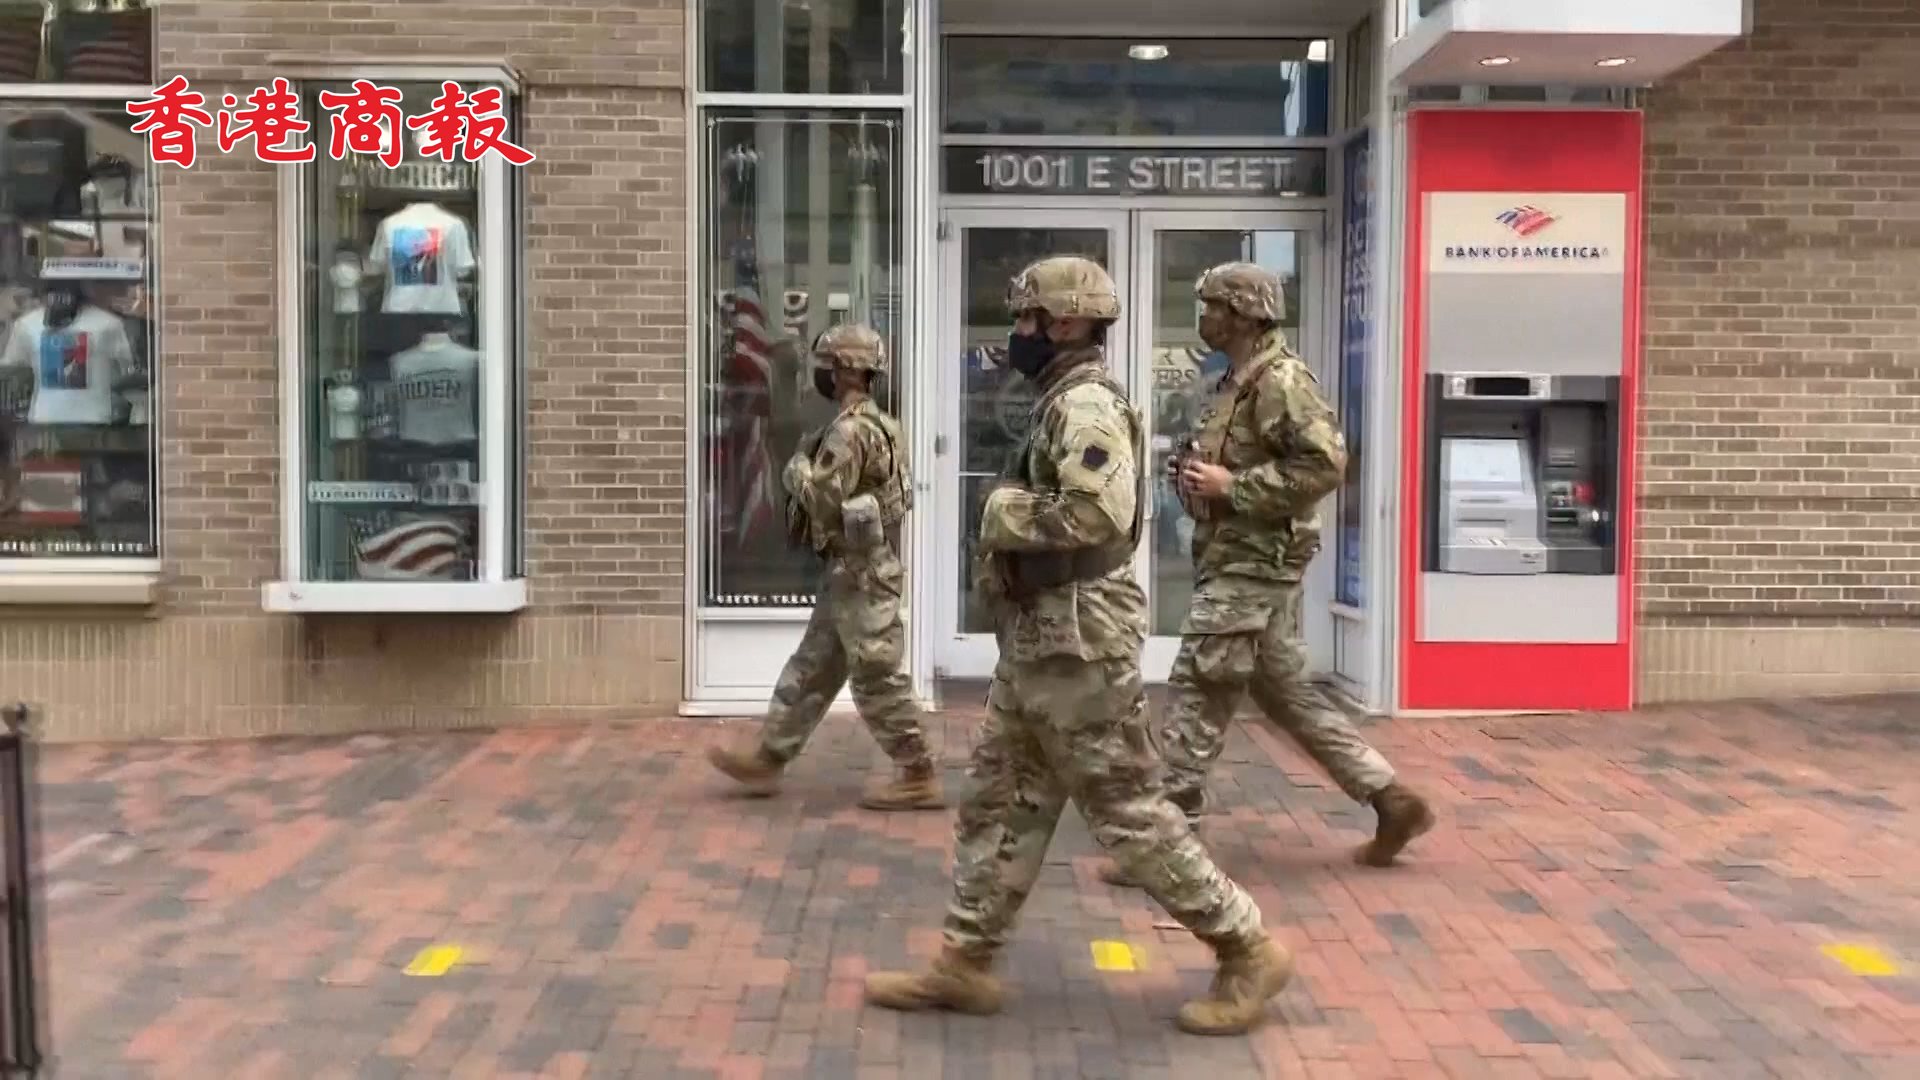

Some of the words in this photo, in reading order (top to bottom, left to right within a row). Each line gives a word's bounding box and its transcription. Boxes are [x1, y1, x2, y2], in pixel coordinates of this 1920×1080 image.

[976, 154, 1070, 188] 1001
[1086, 156, 1112, 189] E
[1127, 156, 1297, 189] STREET
[1445, 246, 1492, 258] BANK
[1497, 246, 1520, 258] OF
[1522, 246, 1601, 258] AMERICA
